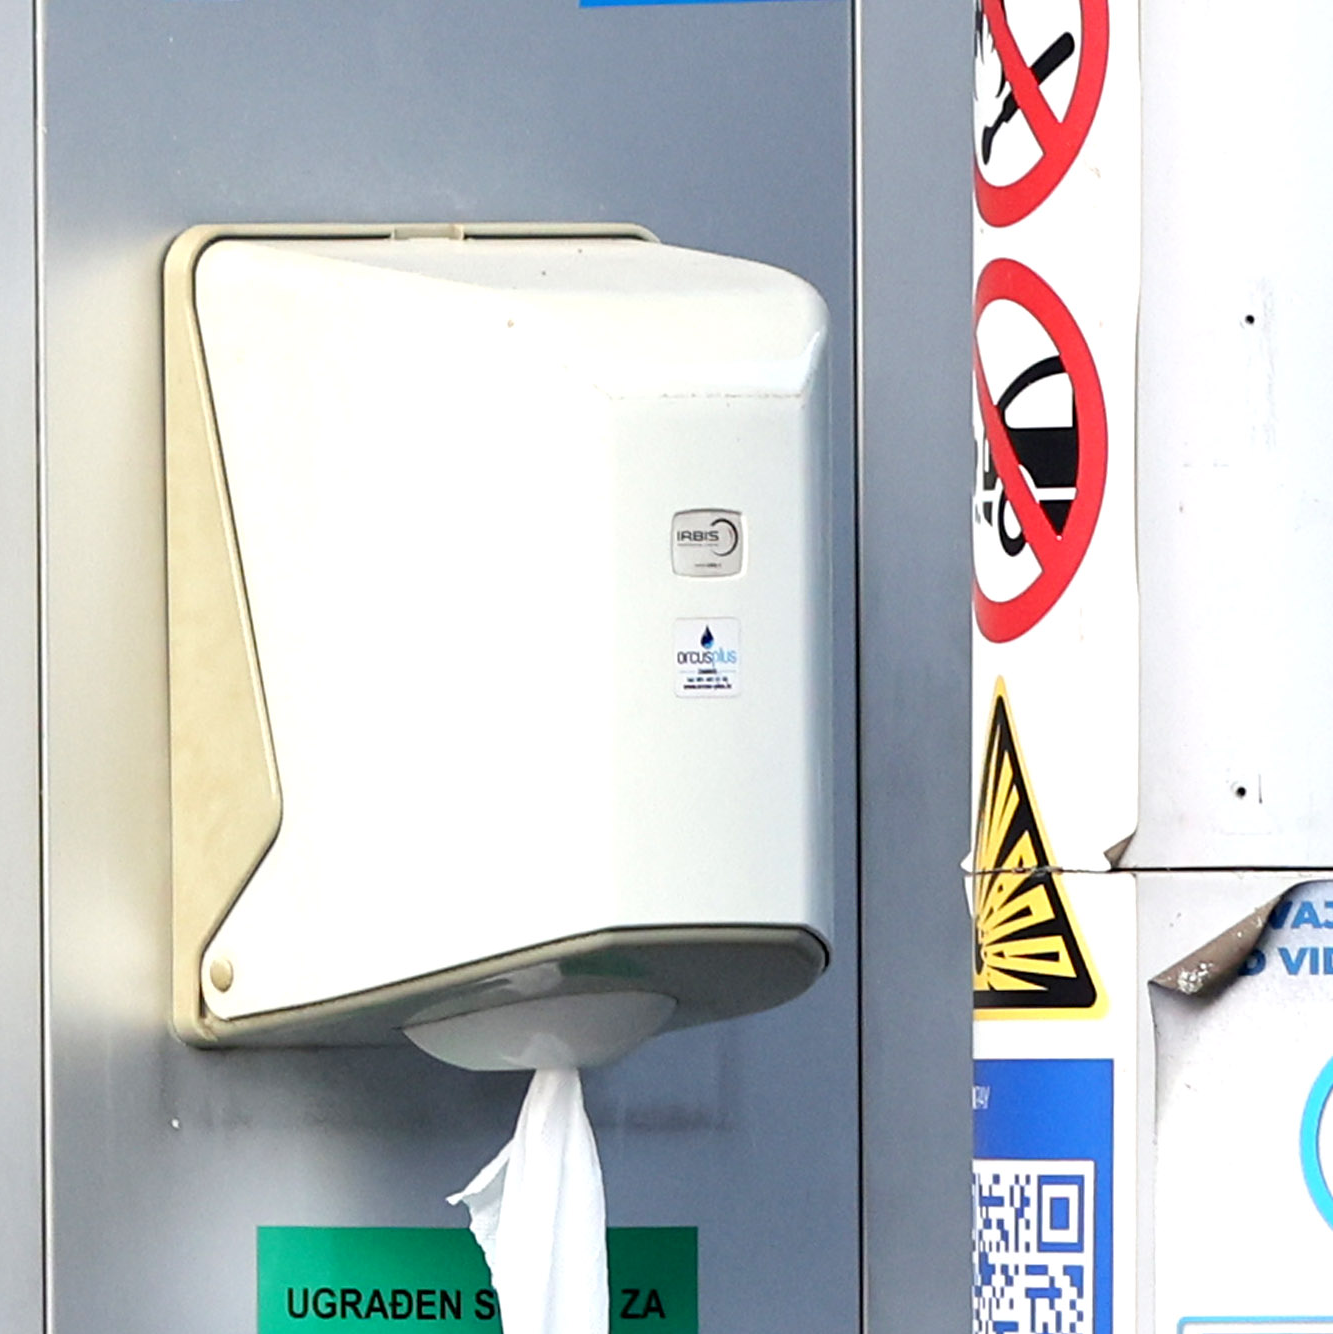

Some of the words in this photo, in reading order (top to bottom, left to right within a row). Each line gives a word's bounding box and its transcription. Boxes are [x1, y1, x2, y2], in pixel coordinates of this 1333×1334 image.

[676, 530, 720, 542] IRBIS
[286, 1287, 462, 1320] UGRAĐEN
[620, 1287, 667, 1319] ZA
